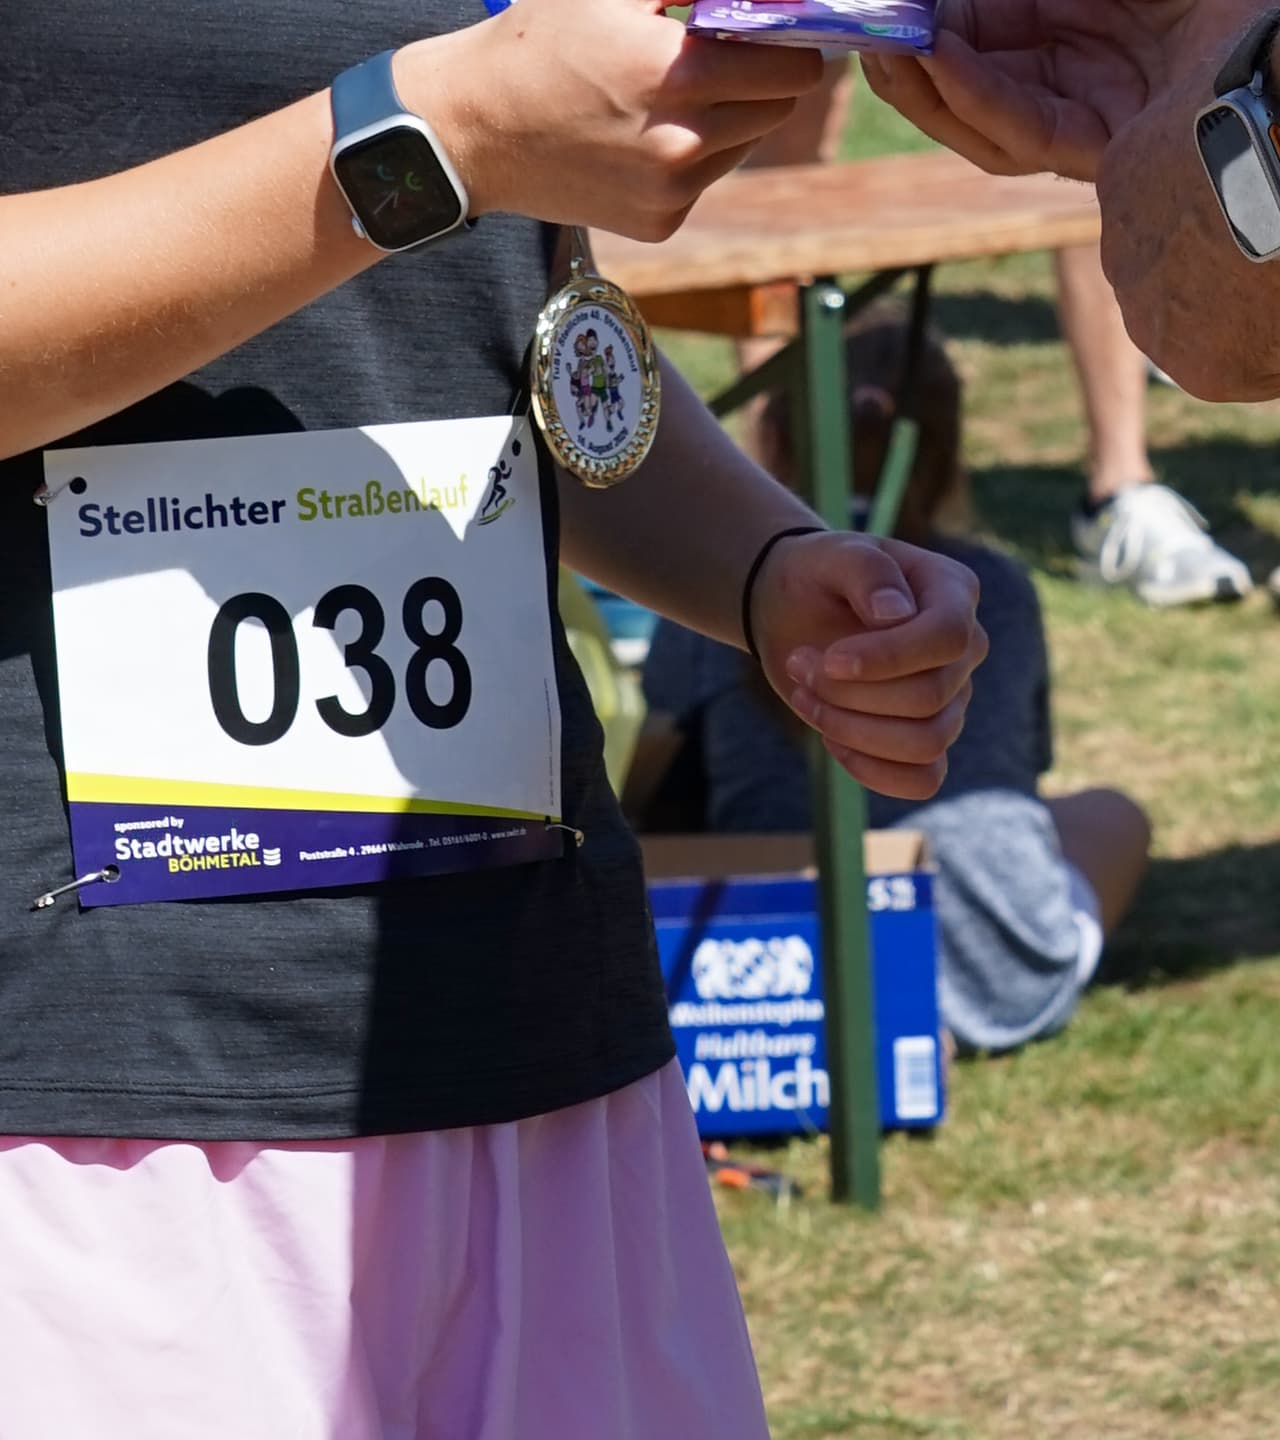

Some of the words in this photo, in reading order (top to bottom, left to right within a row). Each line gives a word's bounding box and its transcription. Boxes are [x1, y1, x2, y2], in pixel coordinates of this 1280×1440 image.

[77, 493, 286, 538] Stellichter
[296, 475, 468, 522] Straßenlauf
[207, 576, 472, 746] 038
[114, 816, 169, 833] sponsored
[170, 816, 184, 829] by
[115, 828, 260, 860] Stadtwerke
[168, 852, 261, 872] BÖHMETAL
[687, 1054, 831, 1113] Milch
